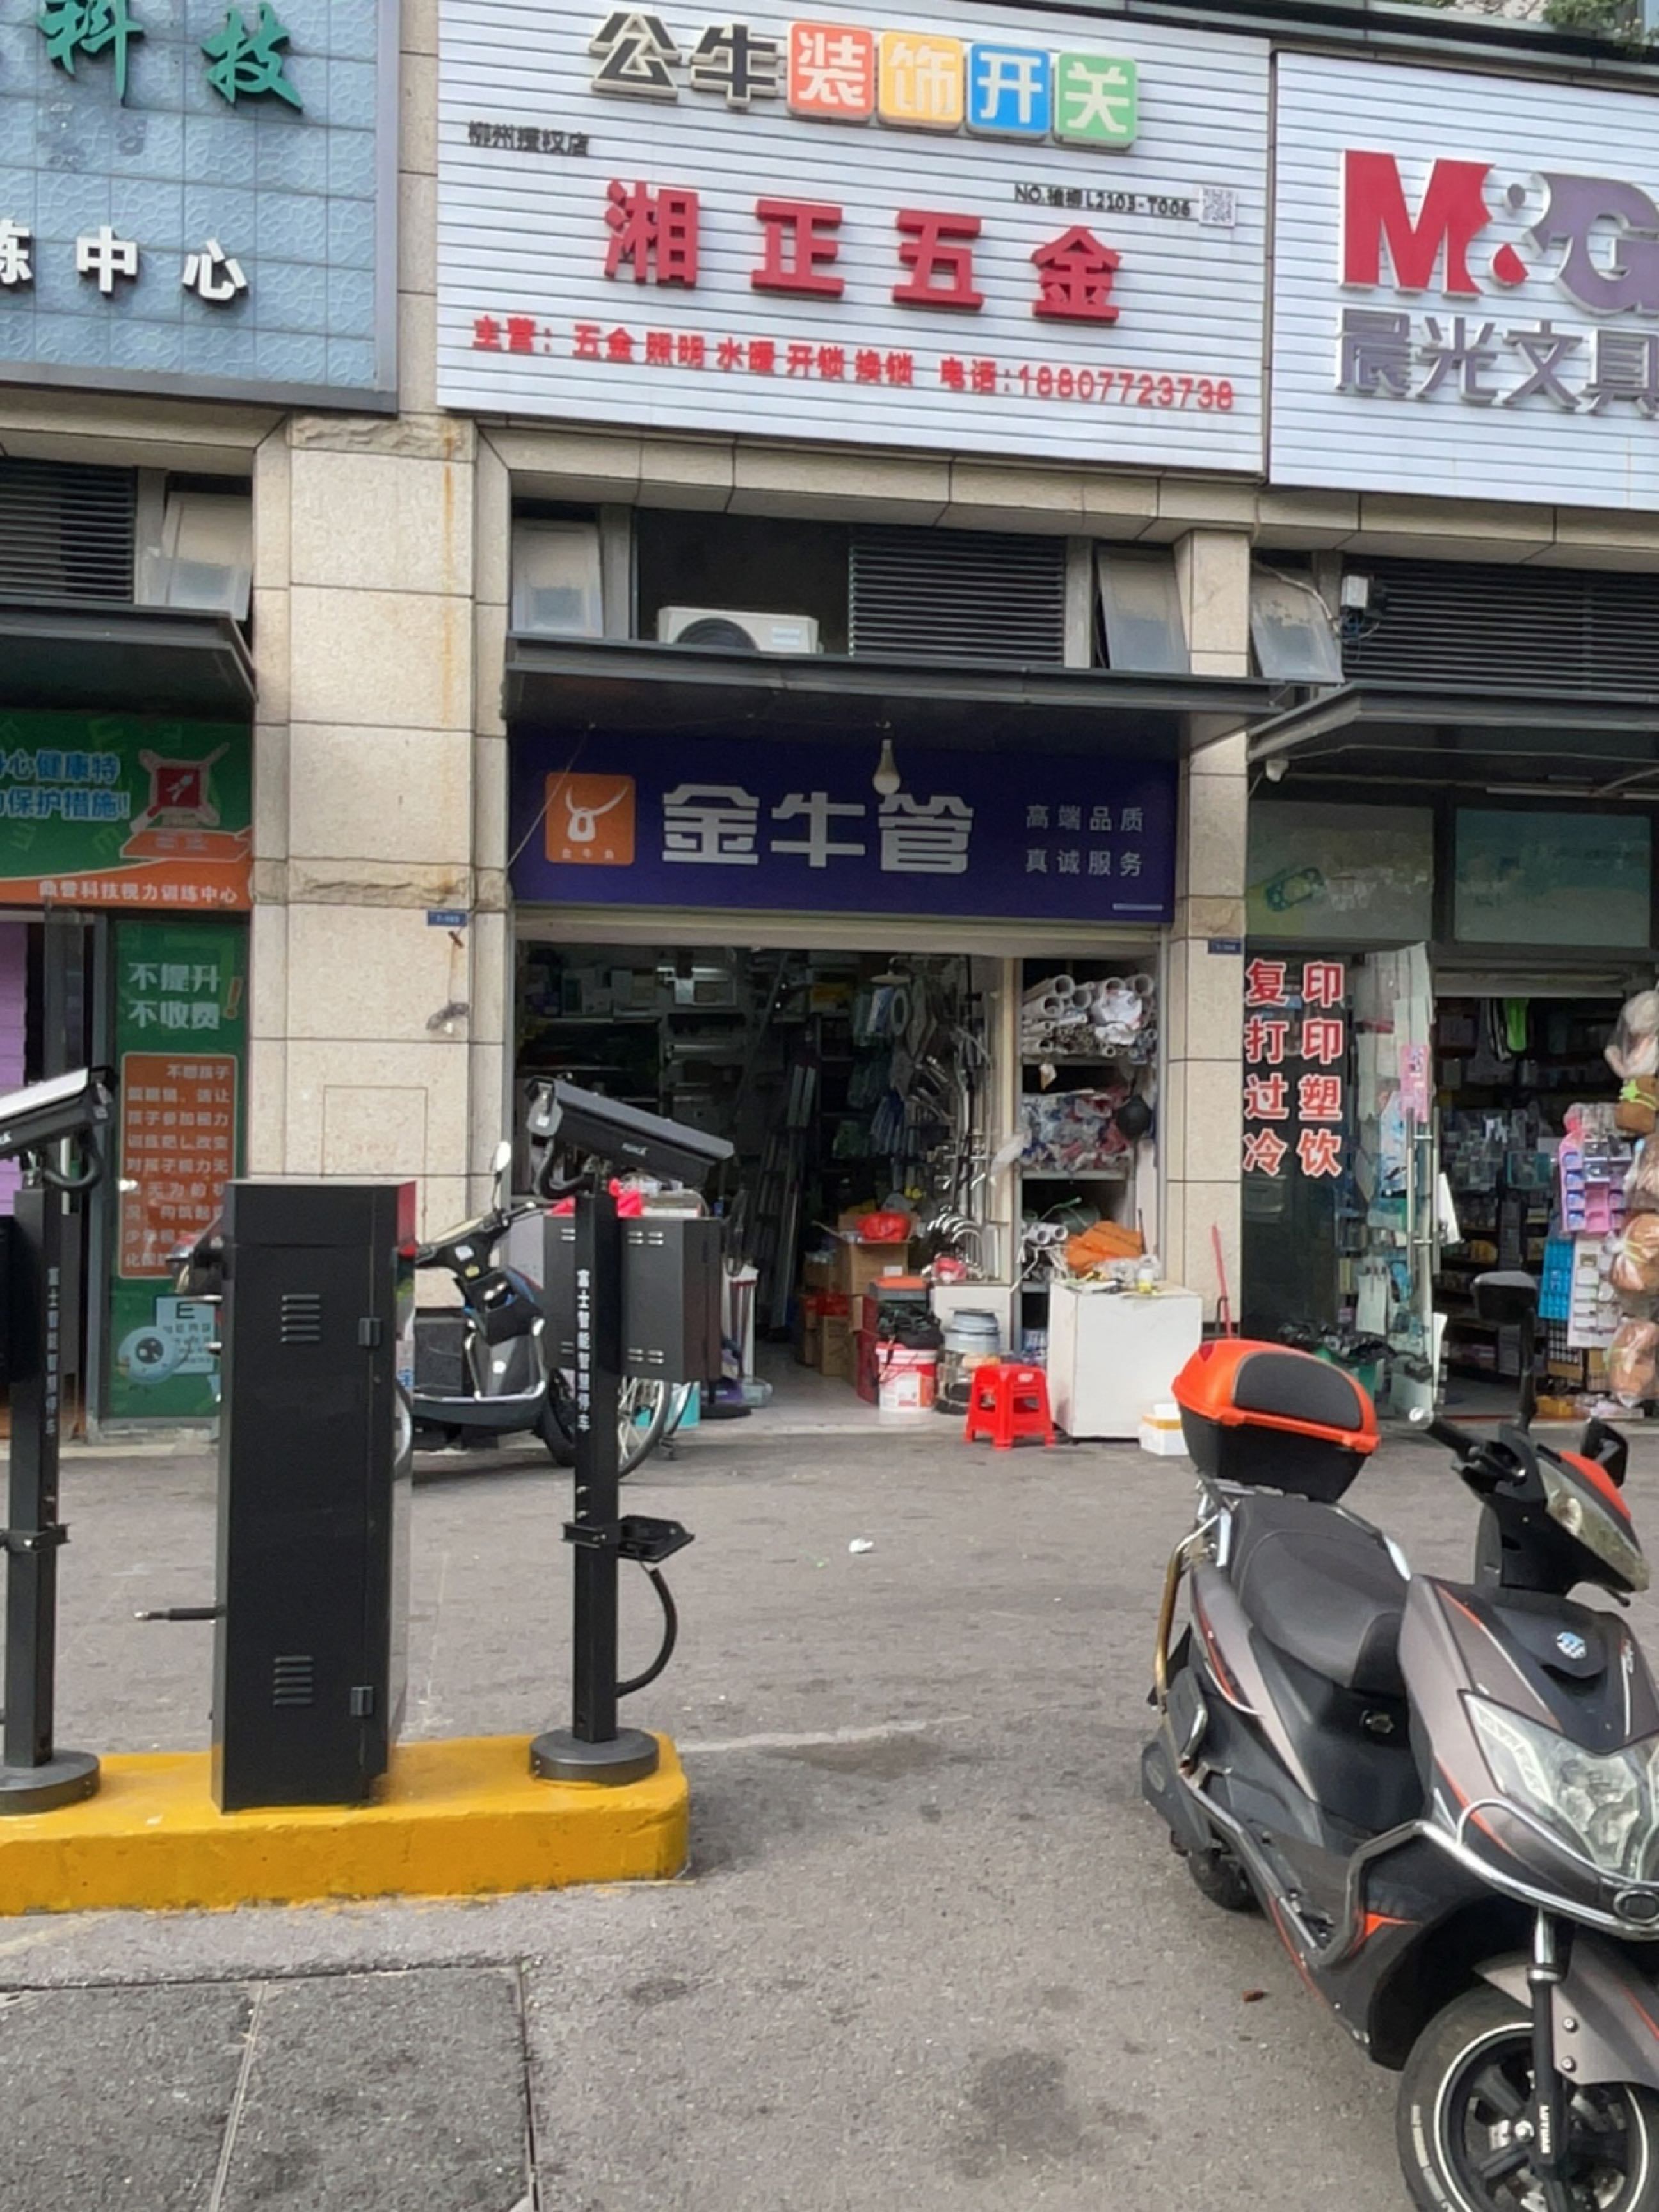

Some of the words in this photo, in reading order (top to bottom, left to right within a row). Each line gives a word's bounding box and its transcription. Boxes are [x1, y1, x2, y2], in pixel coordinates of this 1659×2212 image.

[604, 179, 1121, 326] 湘正五金
[1337, 309, 1659, 418] 晨光文具
[0, 749, 120, 785] 心健康特
[662, 783, 974, 874] 金牛管
[1027, 805, 1143, 831] 高端品质
[1027, 849, 1142, 876] 真诚服务
[1245, 958, 1344, 1007] 复印
[1244, 1015, 1343, 1065] 打印
[1244, 1072, 1343, 1121] 过塑
[1242, 1128, 1342, 1178] 冷饮
